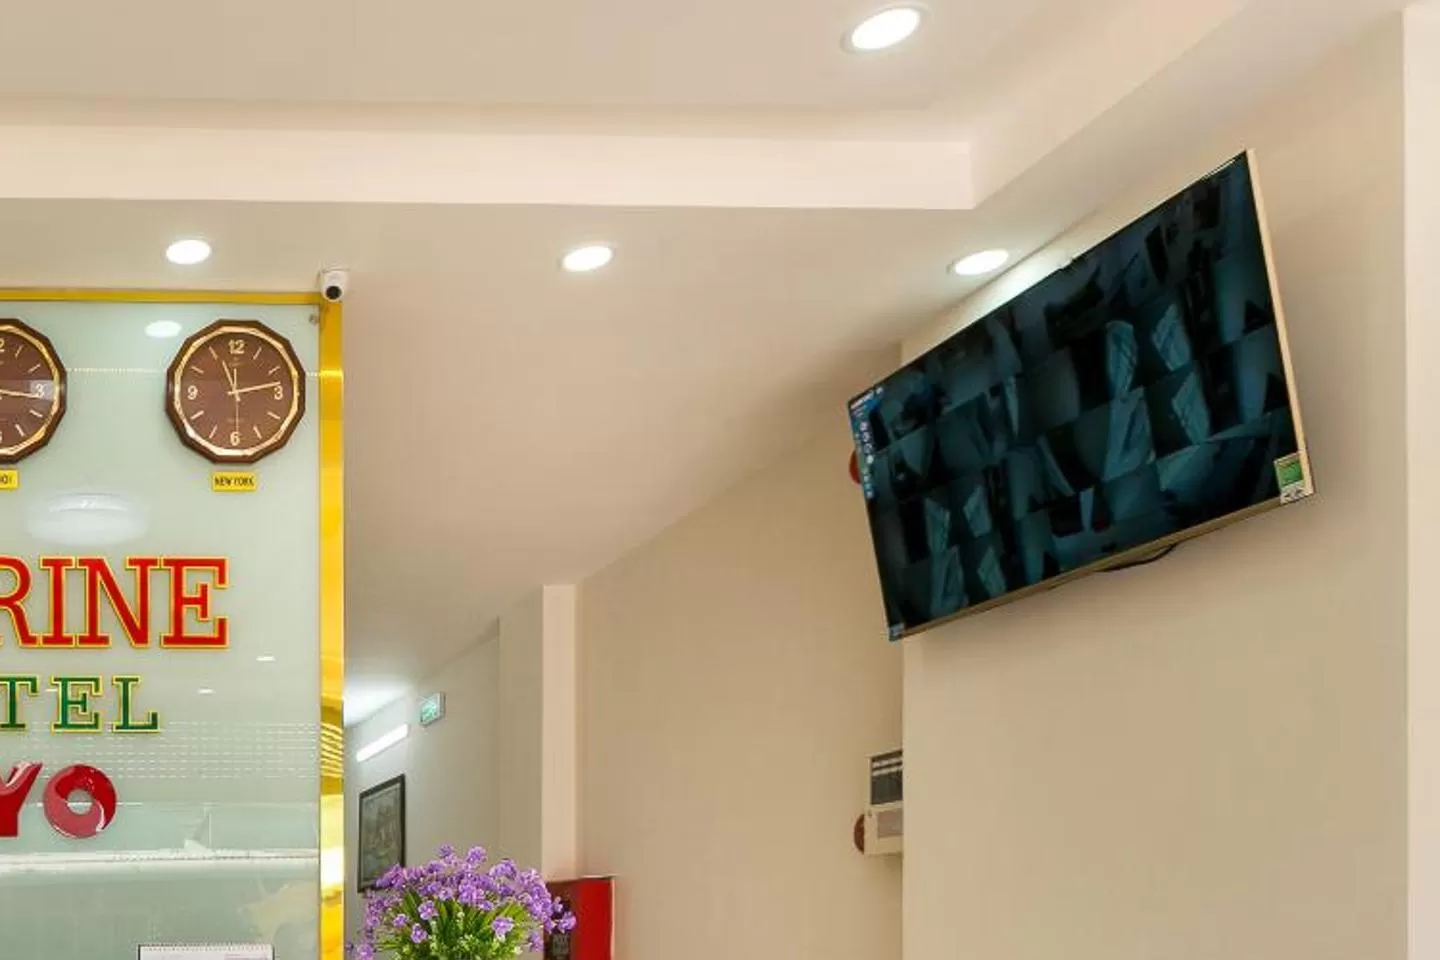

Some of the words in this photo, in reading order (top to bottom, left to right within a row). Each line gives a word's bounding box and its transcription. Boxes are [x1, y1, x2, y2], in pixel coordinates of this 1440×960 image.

[228, 339, 245, 354] 12
[35, 383, 45, 398] 3
[187, 385, 198, 400] 9
[274, 385, 283, 400] 3
[230, 431, 240, 446] 6
[214, 475, 231, 486] NEW
[233, 475, 255, 486] YORK
